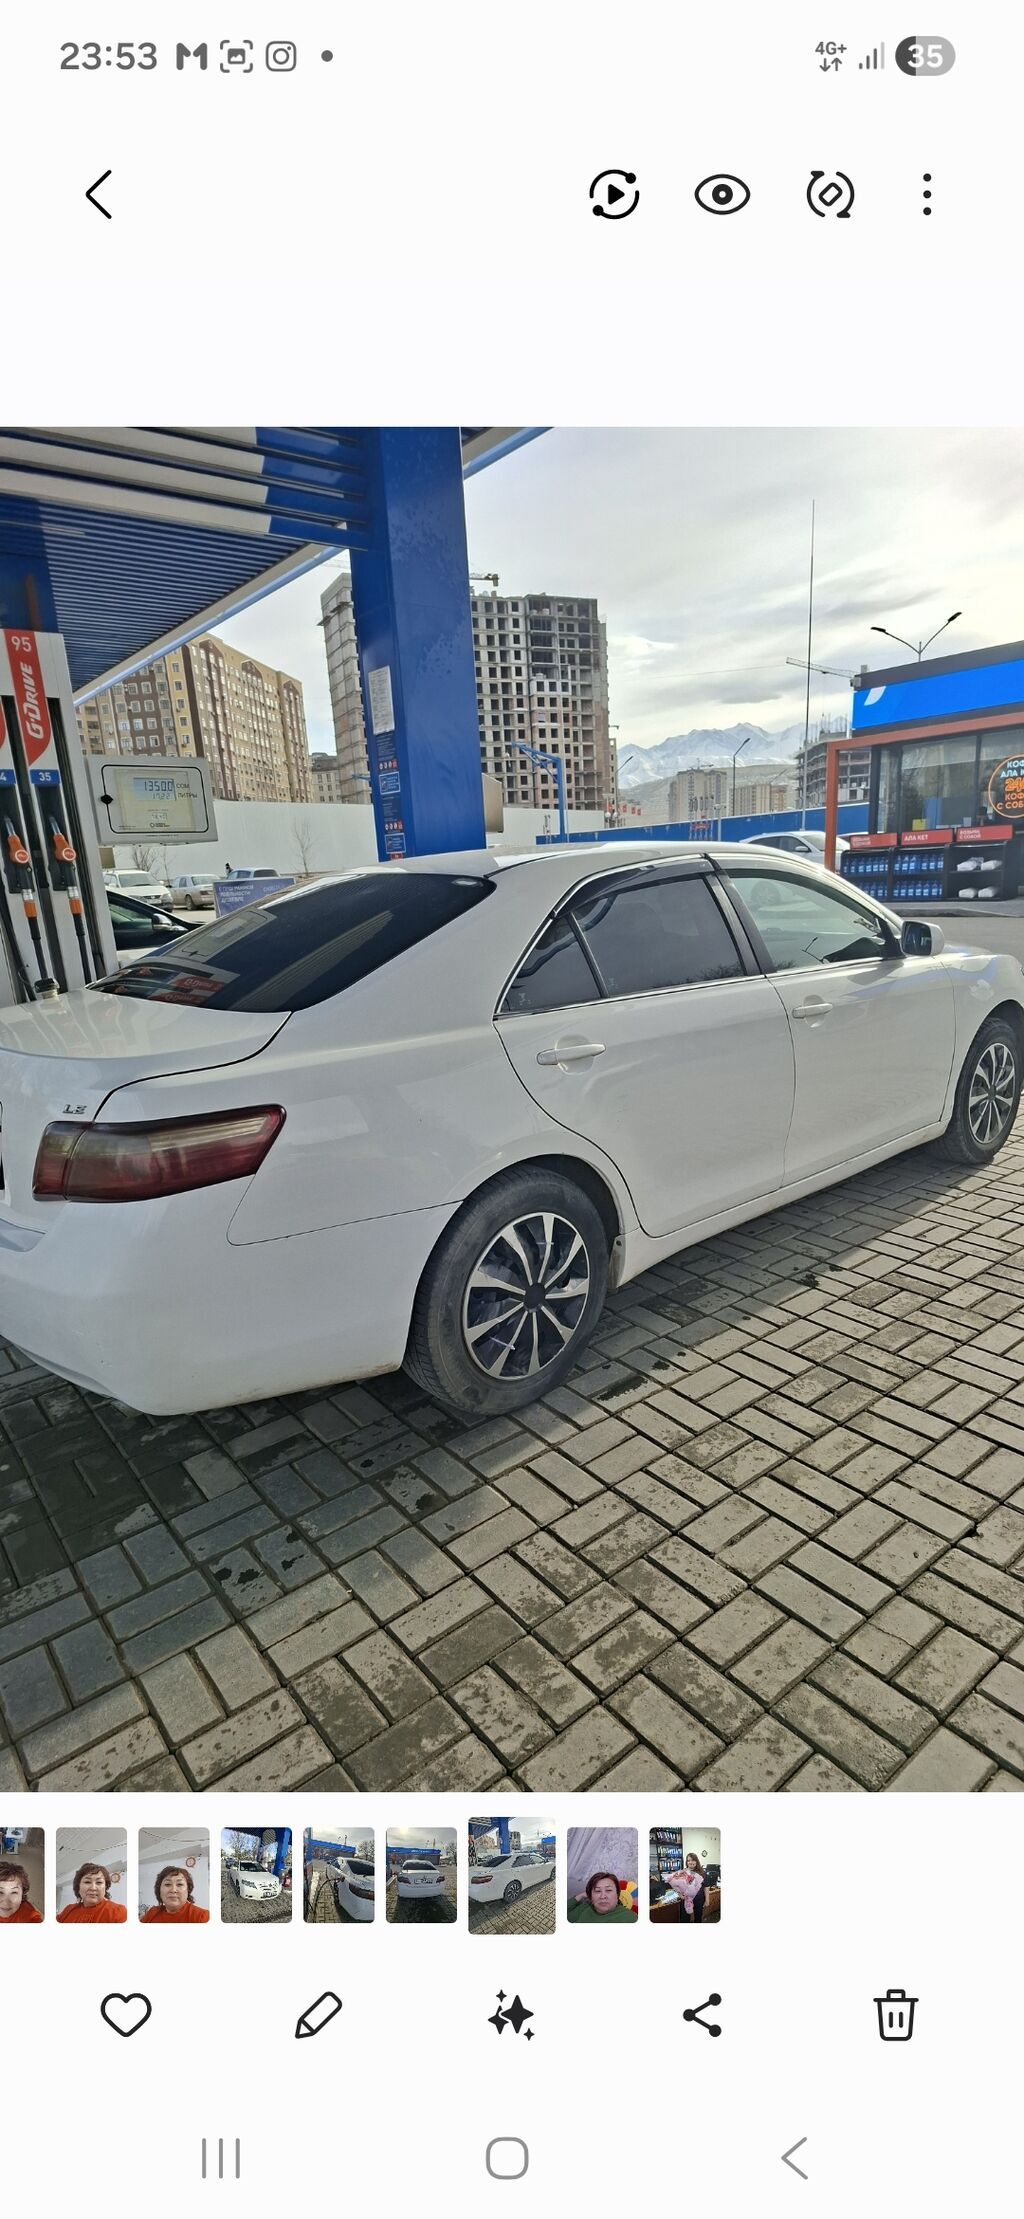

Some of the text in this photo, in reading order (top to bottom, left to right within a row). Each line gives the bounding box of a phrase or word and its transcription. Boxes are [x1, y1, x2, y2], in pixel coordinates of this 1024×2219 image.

[11, 635, 32, 652] 95
[39, 772, 51, 782] 35
[1000, 769, 1018, 778] АЛА
[997, 802, 1004, 810] С
